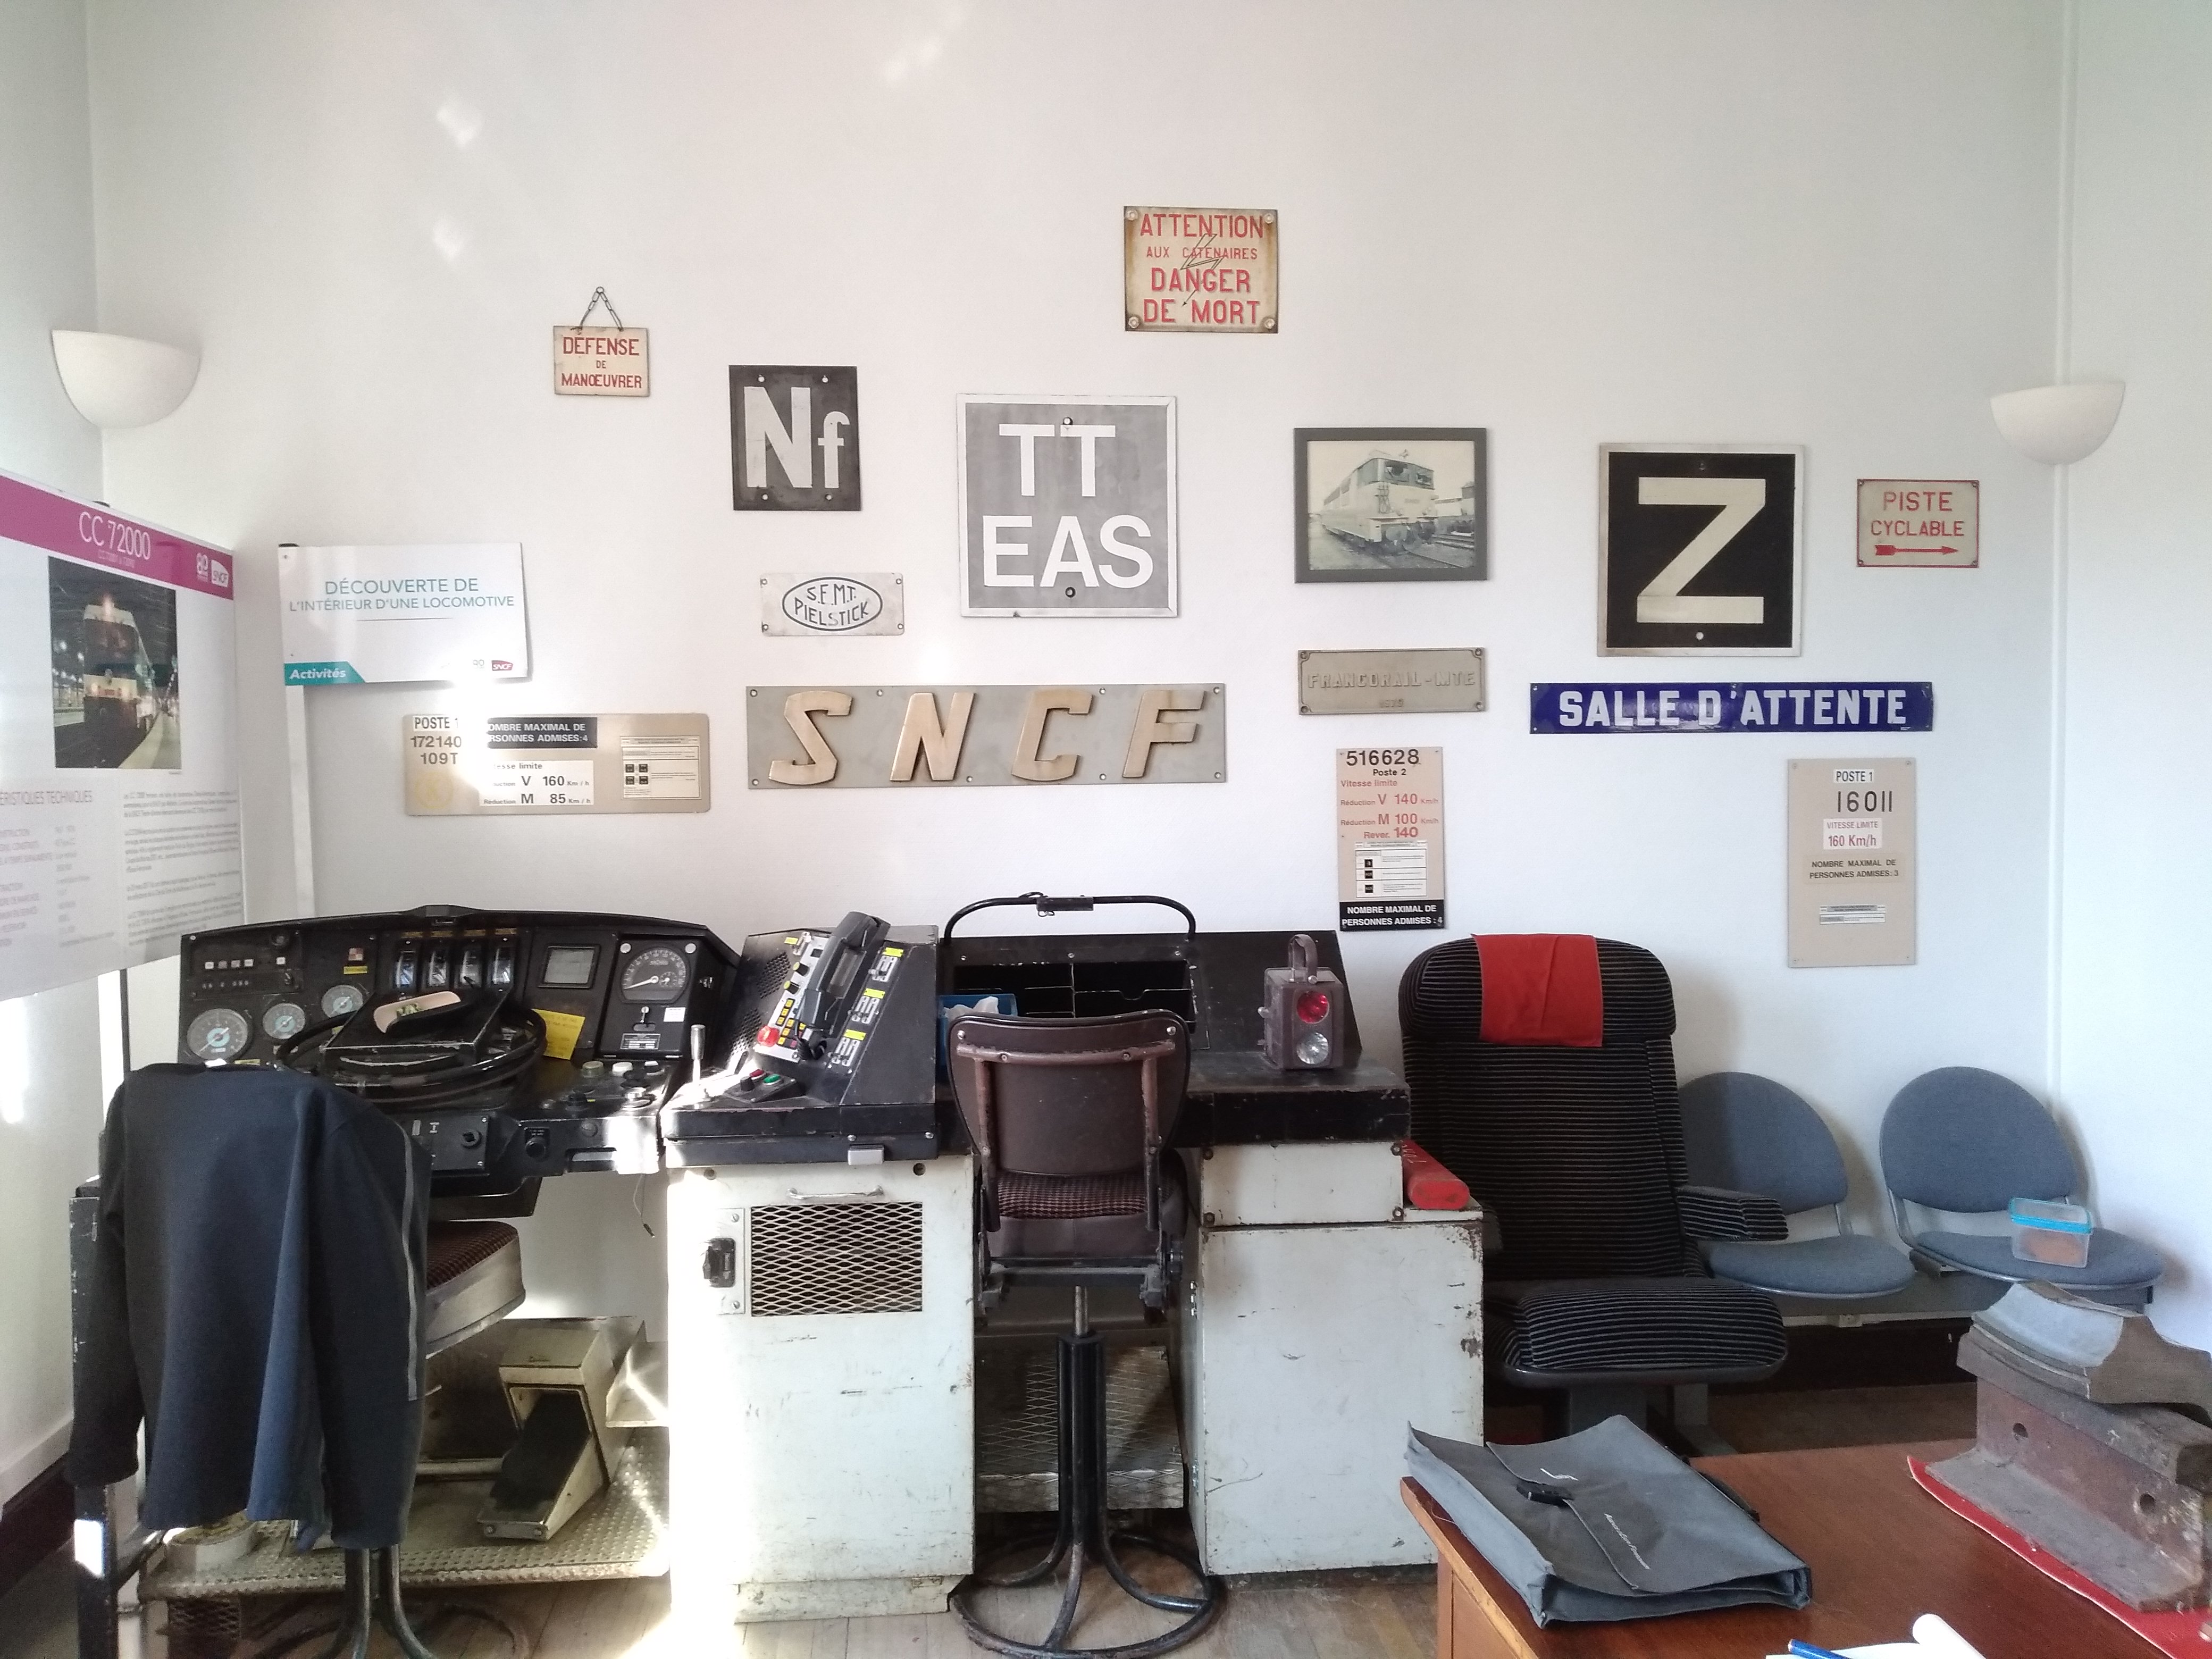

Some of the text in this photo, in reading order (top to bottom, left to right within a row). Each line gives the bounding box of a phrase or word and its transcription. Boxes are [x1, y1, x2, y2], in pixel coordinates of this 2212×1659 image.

[1140, 213, 1264, 238] ATTENTION
[1146, 246, 1258, 259] AUX CATENAIRES
[1151, 267, 1251, 292] DANGER
[1143, 299, 1260, 324] DE MORT
[563, 337, 639, 356] DEFENSE
[596, 360, 607, 369] DE
[744, 386, 850, 489] Nf
[999, 424, 1116, 497] TT
[1883, 491, 1953, 512] PISTE
[79, 512, 104, 546] CC
[107, 520, 151, 560] 72000
[1871, 520, 1964, 537] CYCLABLE
[983, 514, 1153, 589] EAS
[1637, 477, 1766, 624] Z
[325, 577, 479, 595] DÉCOUVERTE DE
[289, 596, 514, 611] L'INTÉRIEUR D'UNE LOCOMOTIVE
[794, 597, 869, 626] PIELSTICK
[289, 667, 346, 680] Activités
[1559, 690, 1906, 726] SALLE D'ATTENTE
[414, 717, 450, 729] POSTE
[410, 735, 462, 748] 172140
[769, 689, 1206, 785] SNCF
[1346, 749, 1420, 766] 516628
[521, 776, 531, 786] V
[542, 776, 565, 786] 160
[1836, 770, 1873, 782] POSTE 1
[521, 793, 534, 804] M
[550, 793, 566, 804] 85
[1378, 793, 1387, 805] V
[1394, 793, 1418, 805] 140
[1837, 790, 1892, 812] 16011
[1378, 813, 1389, 825] M
[1395, 813, 1418, 825] 100
[1394, 826, 1419, 838] 140
[1828, 834, 1876, 847] 160 Km/h
[1342, 918, 1393, 926] PERSONNES
